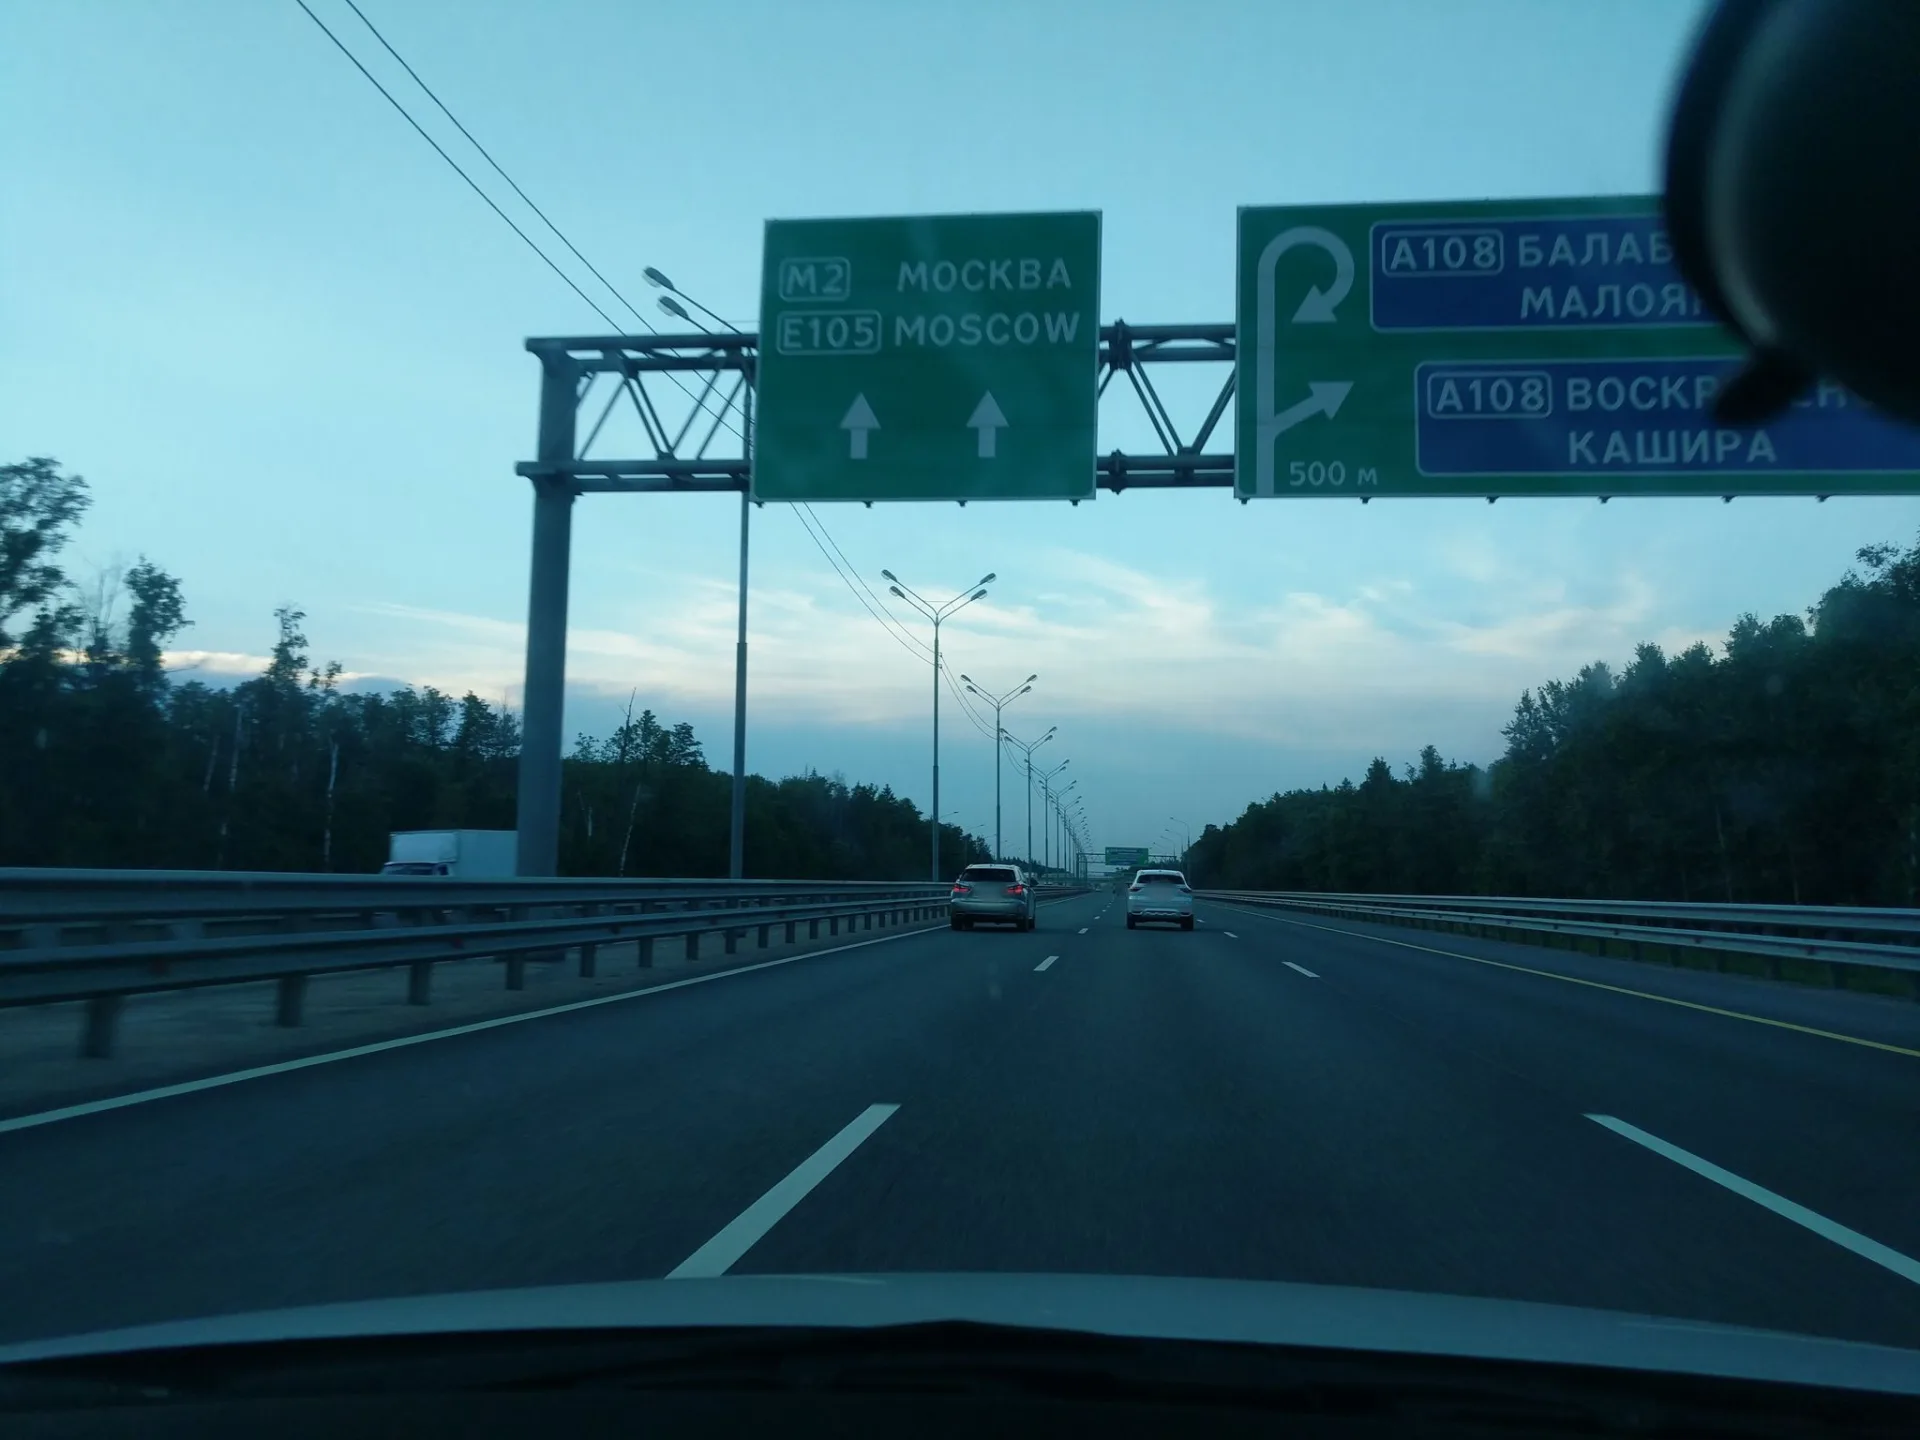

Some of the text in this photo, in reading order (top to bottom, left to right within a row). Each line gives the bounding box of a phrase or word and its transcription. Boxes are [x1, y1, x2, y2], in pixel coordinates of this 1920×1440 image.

[1518, 233, 1674, 268] БАЛАБ
[785, 263, 844, 296] M2
[896, 257, 1072, 293] МОСКВА
[1519, 285, 1700, 320] МАЛОЯ
[782, 316, 875, 348] E105
[894, 311, 1080, 346] MOSCOW
[1569, 429, 1778, 466] КАШИРА
[1289, 460, 1346, 487] 500
